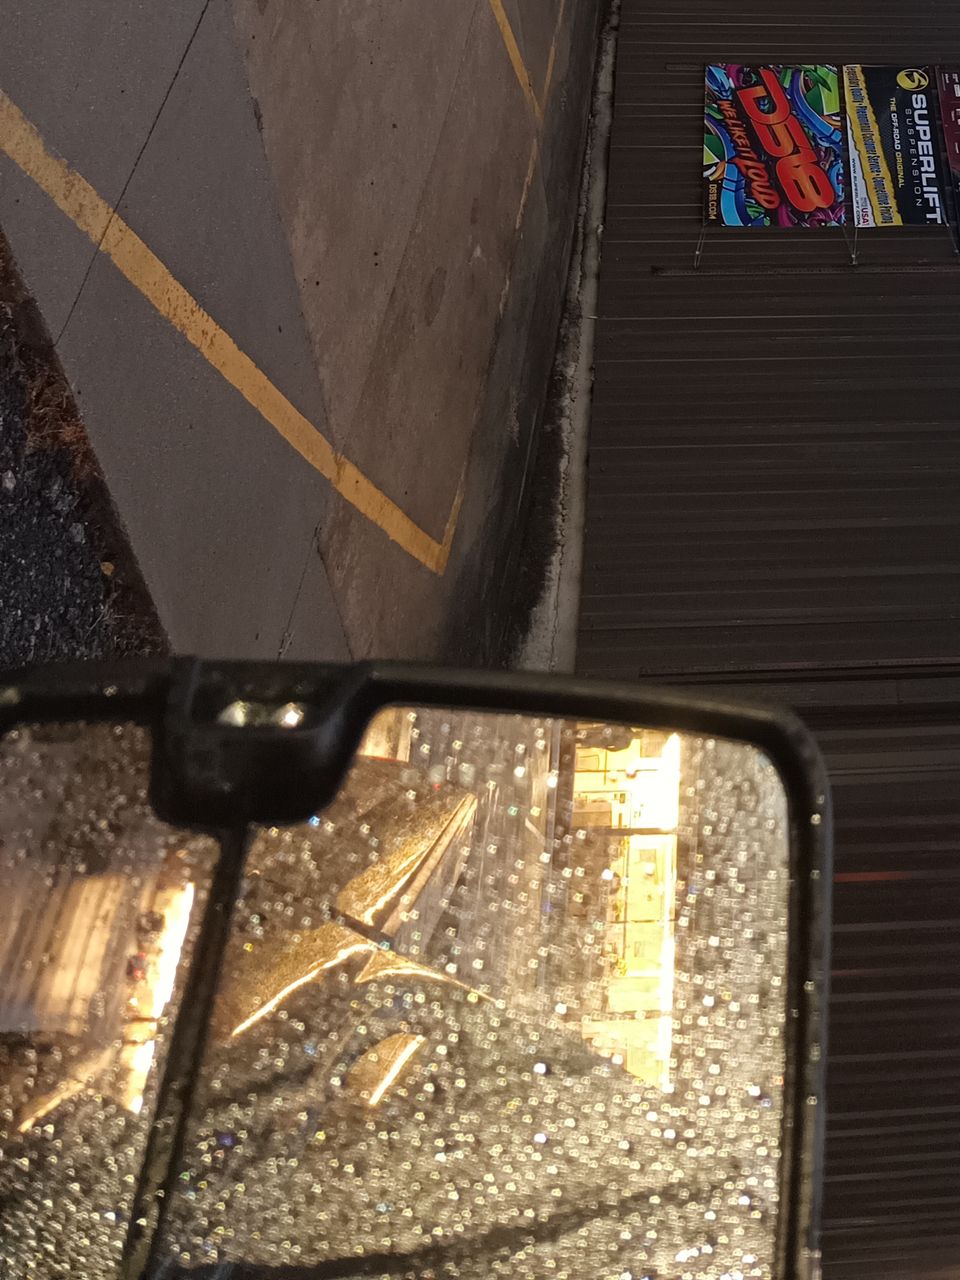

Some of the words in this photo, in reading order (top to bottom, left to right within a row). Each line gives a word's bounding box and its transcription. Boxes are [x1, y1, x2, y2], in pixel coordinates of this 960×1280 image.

[718, 100, 736, 118] WE
[889, 97, 897, 111] THE
[723, 118, 751, 146] LIKE
[736, 68, 835, 213] DS18
[891, 112, 902, 150] OFF-ROAD
[895, 151, 905, 188] ORIGINAL
[904, 108, 923, 207] SUSPENSION
[911, 93, 942, 224] SUPERLIFT
[730, 157, 781, 209] LOUD
[861, 207, 869, 224] USA
